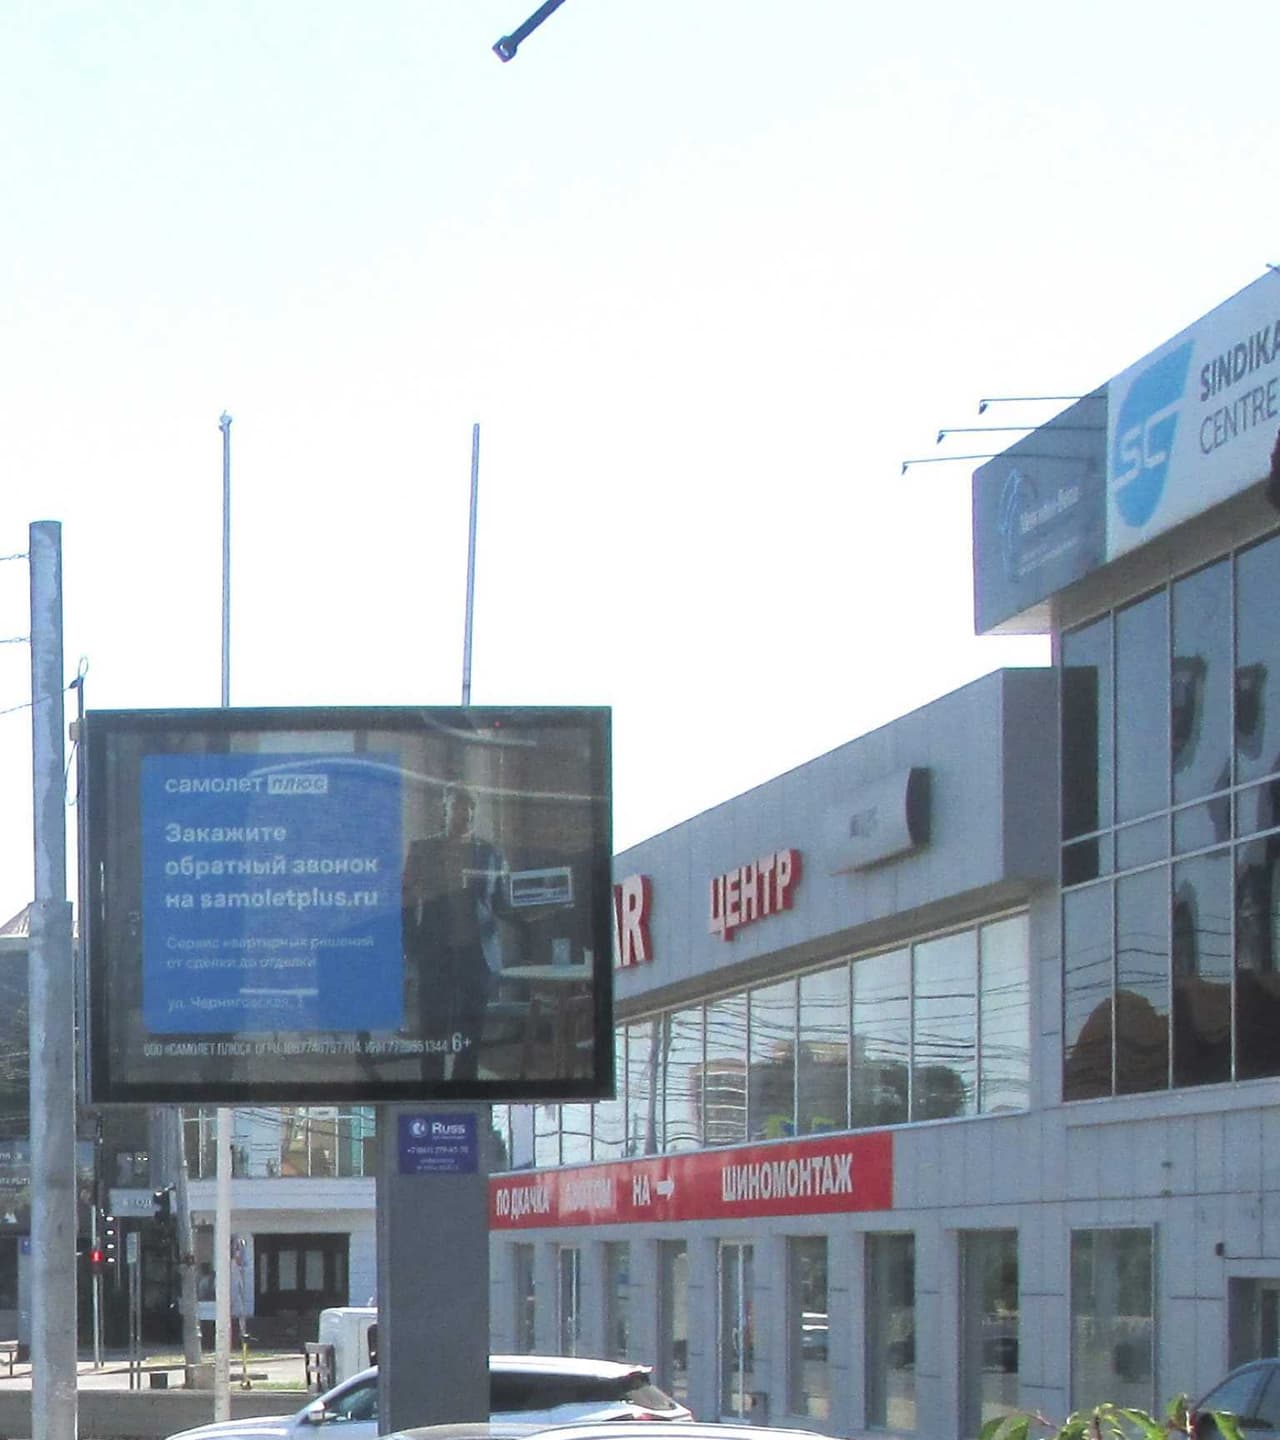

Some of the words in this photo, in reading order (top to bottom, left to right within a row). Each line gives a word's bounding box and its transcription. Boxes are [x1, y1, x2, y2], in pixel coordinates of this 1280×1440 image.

[1199, 376, 1279, 455] CENTRE
[165, 776, 263, 793] самолет
[165, 822, 287, 843] Закажите
[165, 855, 286, 879] обратный
[293, 858, 378, 875] звонок
[166, 894, 194, 908] на
[200, 887, 379, 911] samoletplus.ru
[709, 848, 803, 941] ЦЕНТР
[451, 1031, 472, 1053] 6+
[632, 1174, 652, 1207] НА
[721, 1152, 854, 1202] ШИНОМОНТАЖ
